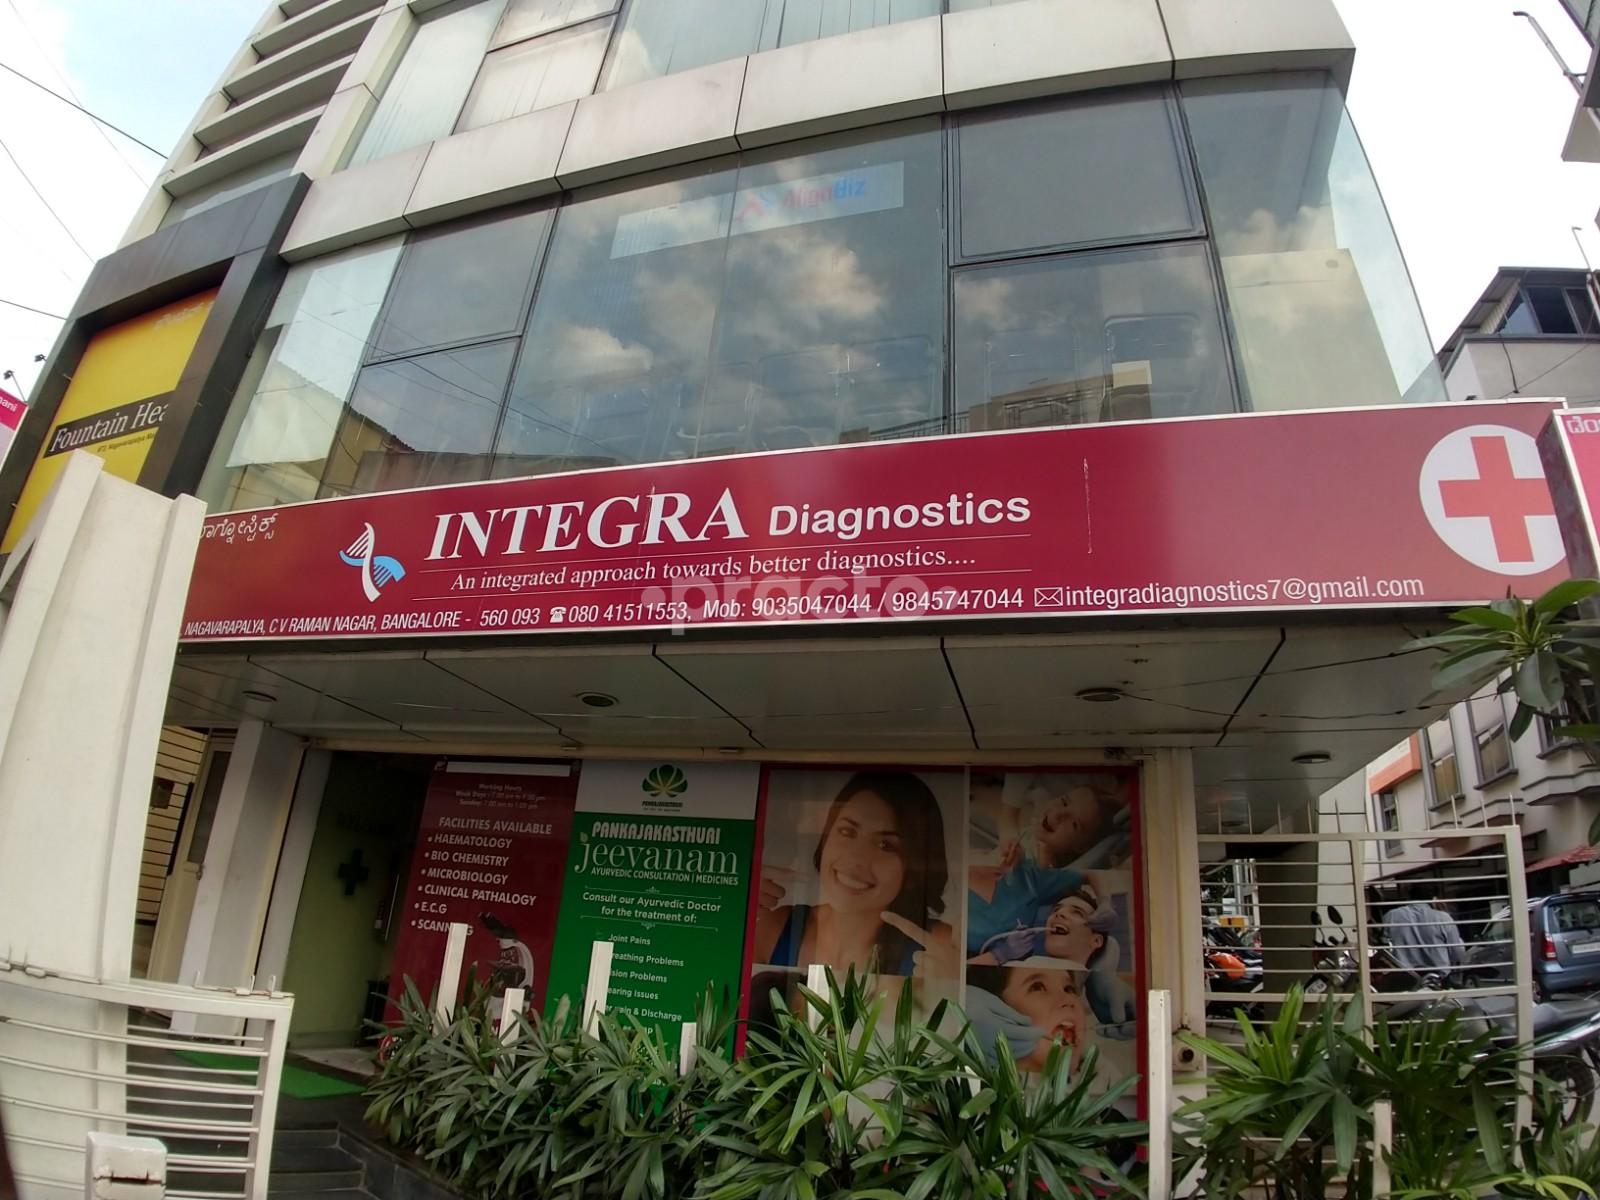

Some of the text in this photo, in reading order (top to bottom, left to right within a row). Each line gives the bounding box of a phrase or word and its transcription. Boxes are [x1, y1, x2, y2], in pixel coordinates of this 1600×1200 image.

[50, 412, 127, 452] Fountain
[424, 487, 1031, 561] INTEGRA Diagnostics
[451, 573, 476, 591] An
[480, 567, 567, 592] integrated
[571, 561, 656, 588] approach
[663, 556, 742, 580] towards
[749, 554, 811, 575] better
[184, 619, 265, 636] NAGAVARAPALYA,
[269, 618, 278, 633] C
[279, 618, 289, 633] V
[289, 616, 331, 632] RAMAN
[332, 615, 377, 632] NAGAR,
[381, 611, 462, 630] BANGALORE
[479, 609, 508, 627] 560
[511, 608, 541, 626] 093
[568, 605, 599, 623] 080
[603, 601, 692, 622] 41511553,
[702, 598, 746, 619] Mob:
[751, 593, 872, 617] 9035047044
[892, 588, 1024, 611] 9845747044
[1066, 575, 1425, 609] integradiagnostics7@gmail.com
[439, 817, 553, 835] FACILITIES AVAILABLE
[434, 833, 512, 849] HAEMATOLOGY
[431, 850, 509, 867] BIO CHEMISTRY
[427, 867, 508, 885] MICROBIOLOGY
[591, 866, 739, 886] AYURVEDIC CONSULTATION MEDICINES
[424, 884, 537, 906] CLINICAL PATHALOGY
[583, 891, 721, 912] Consult our Ayurvedic Doctor
[601, 905, 614, 915] for
[617, 907, 632, 918] the
[635, 909, 681, 921] treatment
[417, 918, 474, 936] SCANNG
[608, 934, 651, 945] Joint Pains
[646, 955, 684, 967] Problems
[629, 971, 668, 983] Problems
[641, 1009, 682, 1022] Discharge
